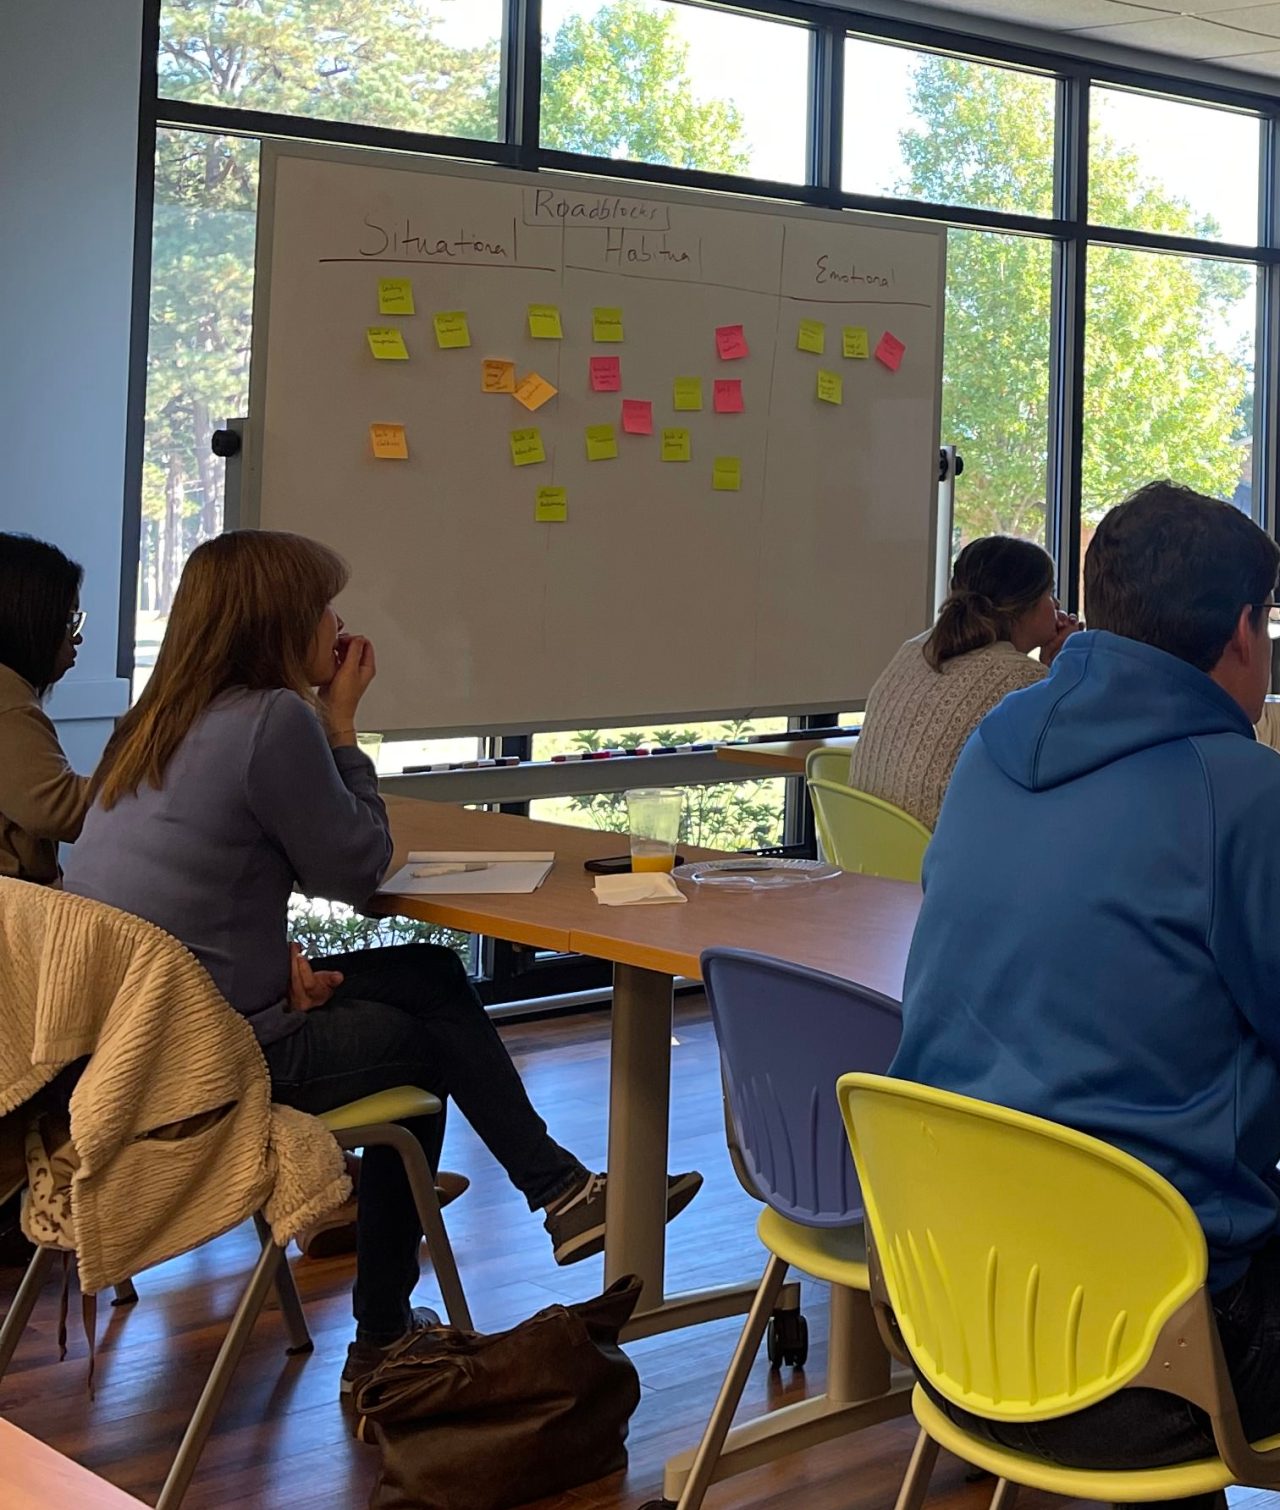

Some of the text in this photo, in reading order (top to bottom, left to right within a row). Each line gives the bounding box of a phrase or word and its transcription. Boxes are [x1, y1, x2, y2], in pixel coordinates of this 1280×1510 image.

[533, 188, 659, 221] Roadblocks
[358, 215, 519, 263] Situational
[815, 253, 895, 290] Emotional
